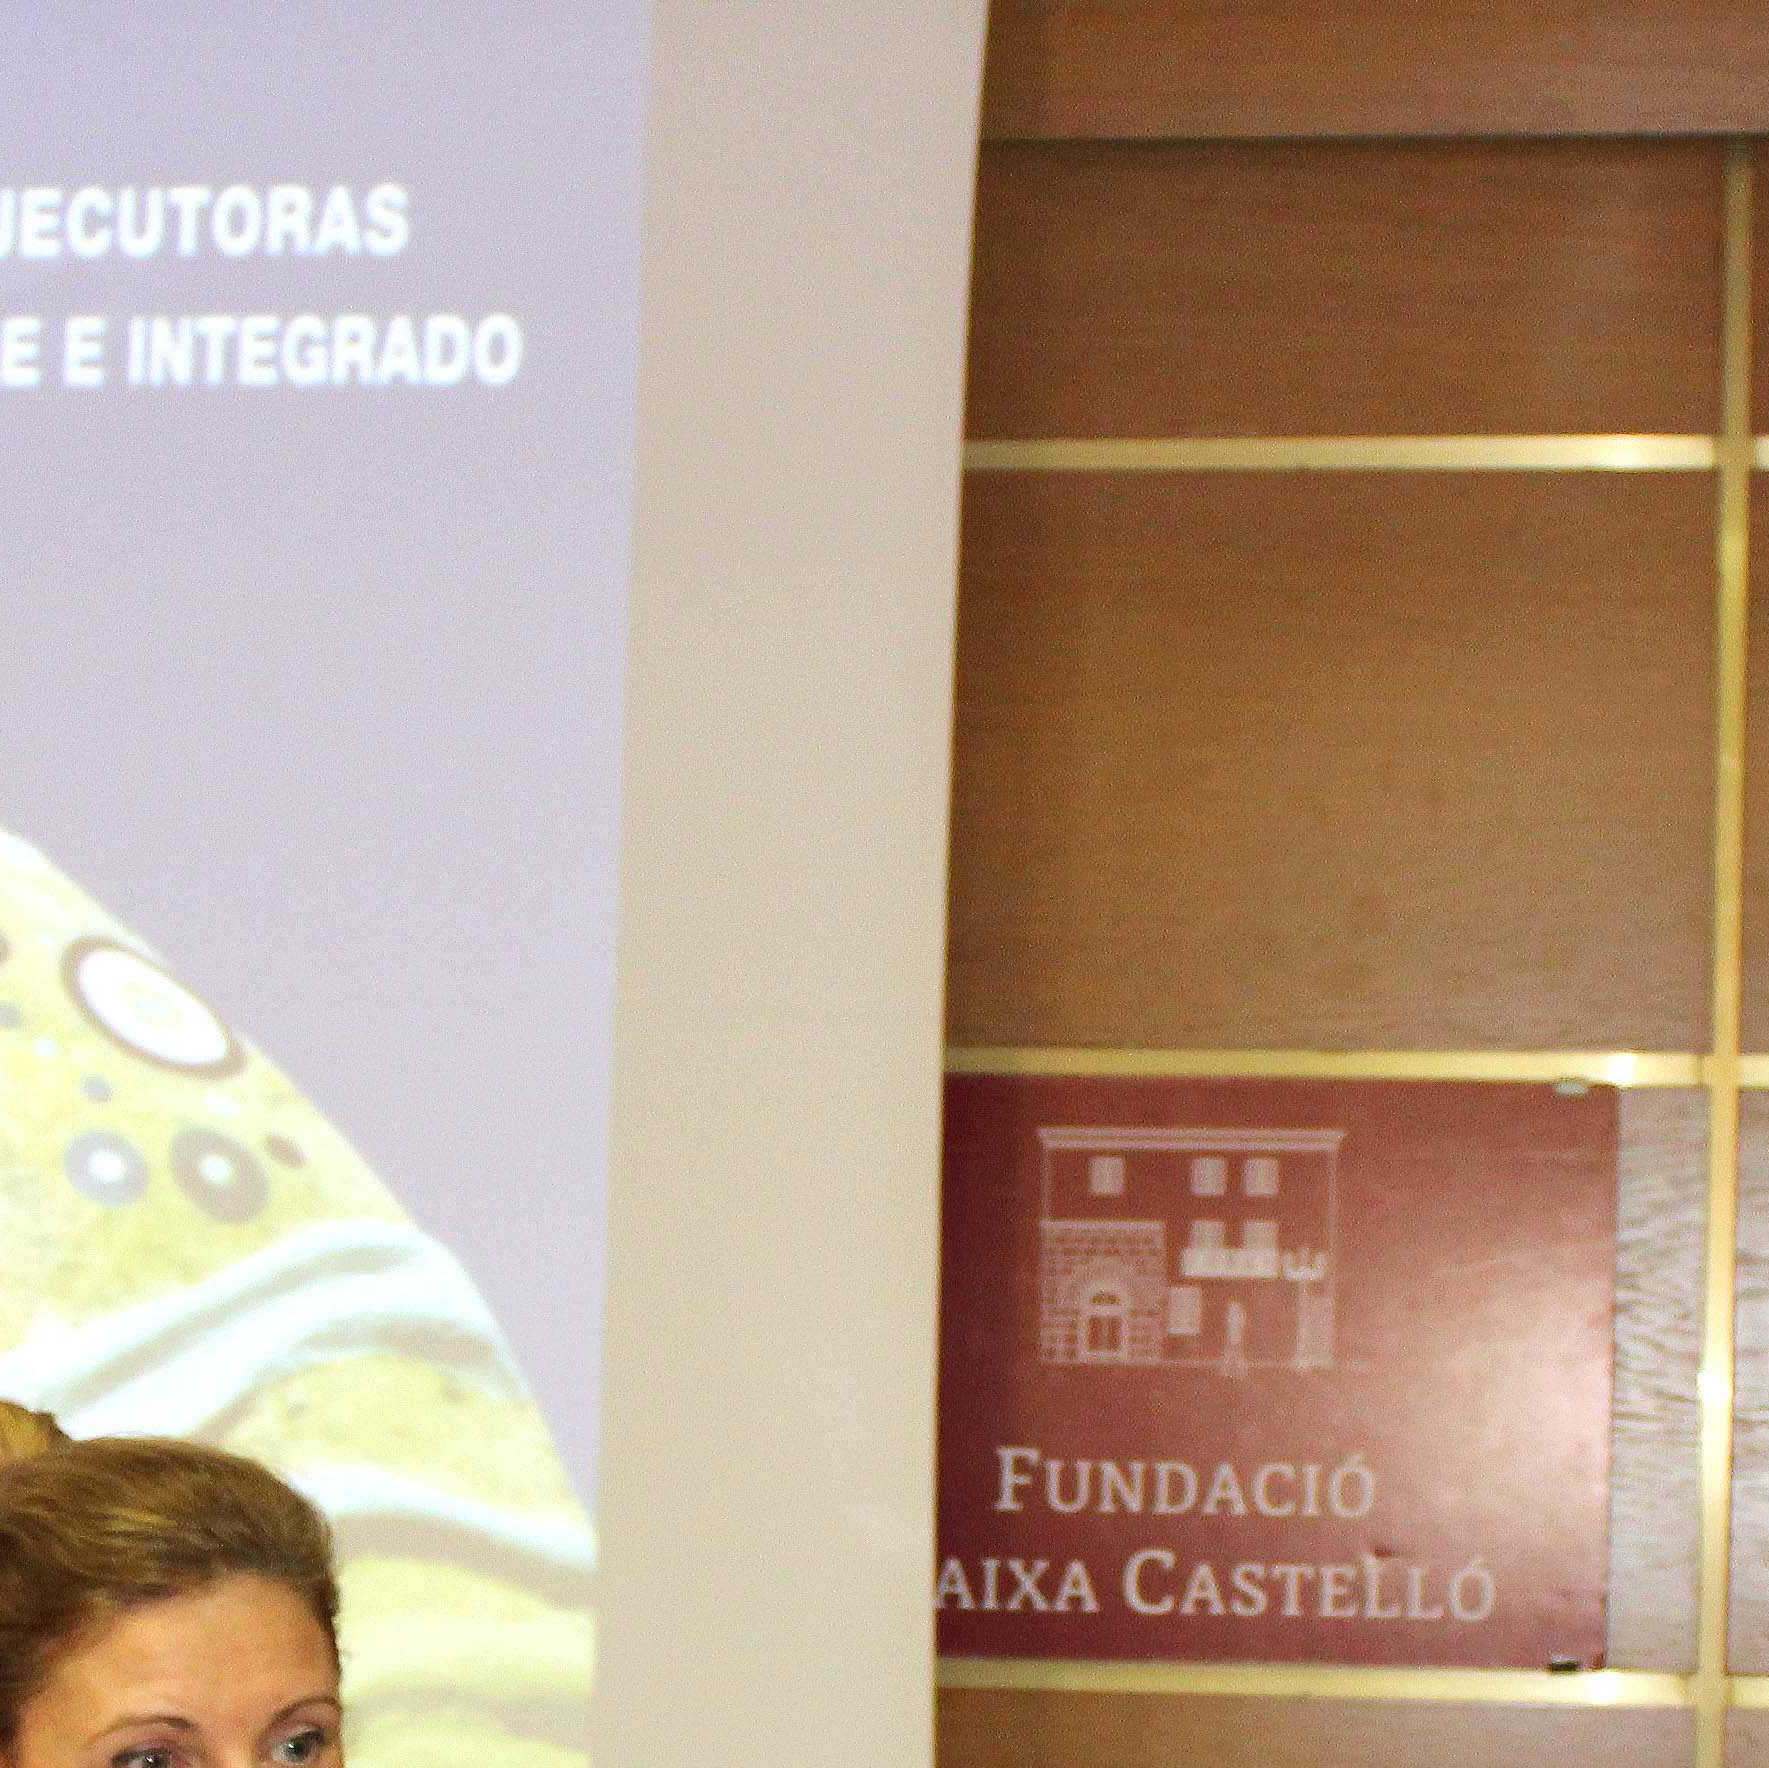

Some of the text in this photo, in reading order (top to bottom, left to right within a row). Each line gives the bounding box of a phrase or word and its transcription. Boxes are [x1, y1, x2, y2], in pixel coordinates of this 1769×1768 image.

[63, 314, 105, 386] E
[127, 312, 523, 386] INTEGRADO
[934, 1557, 1099, 1613] AIXA
